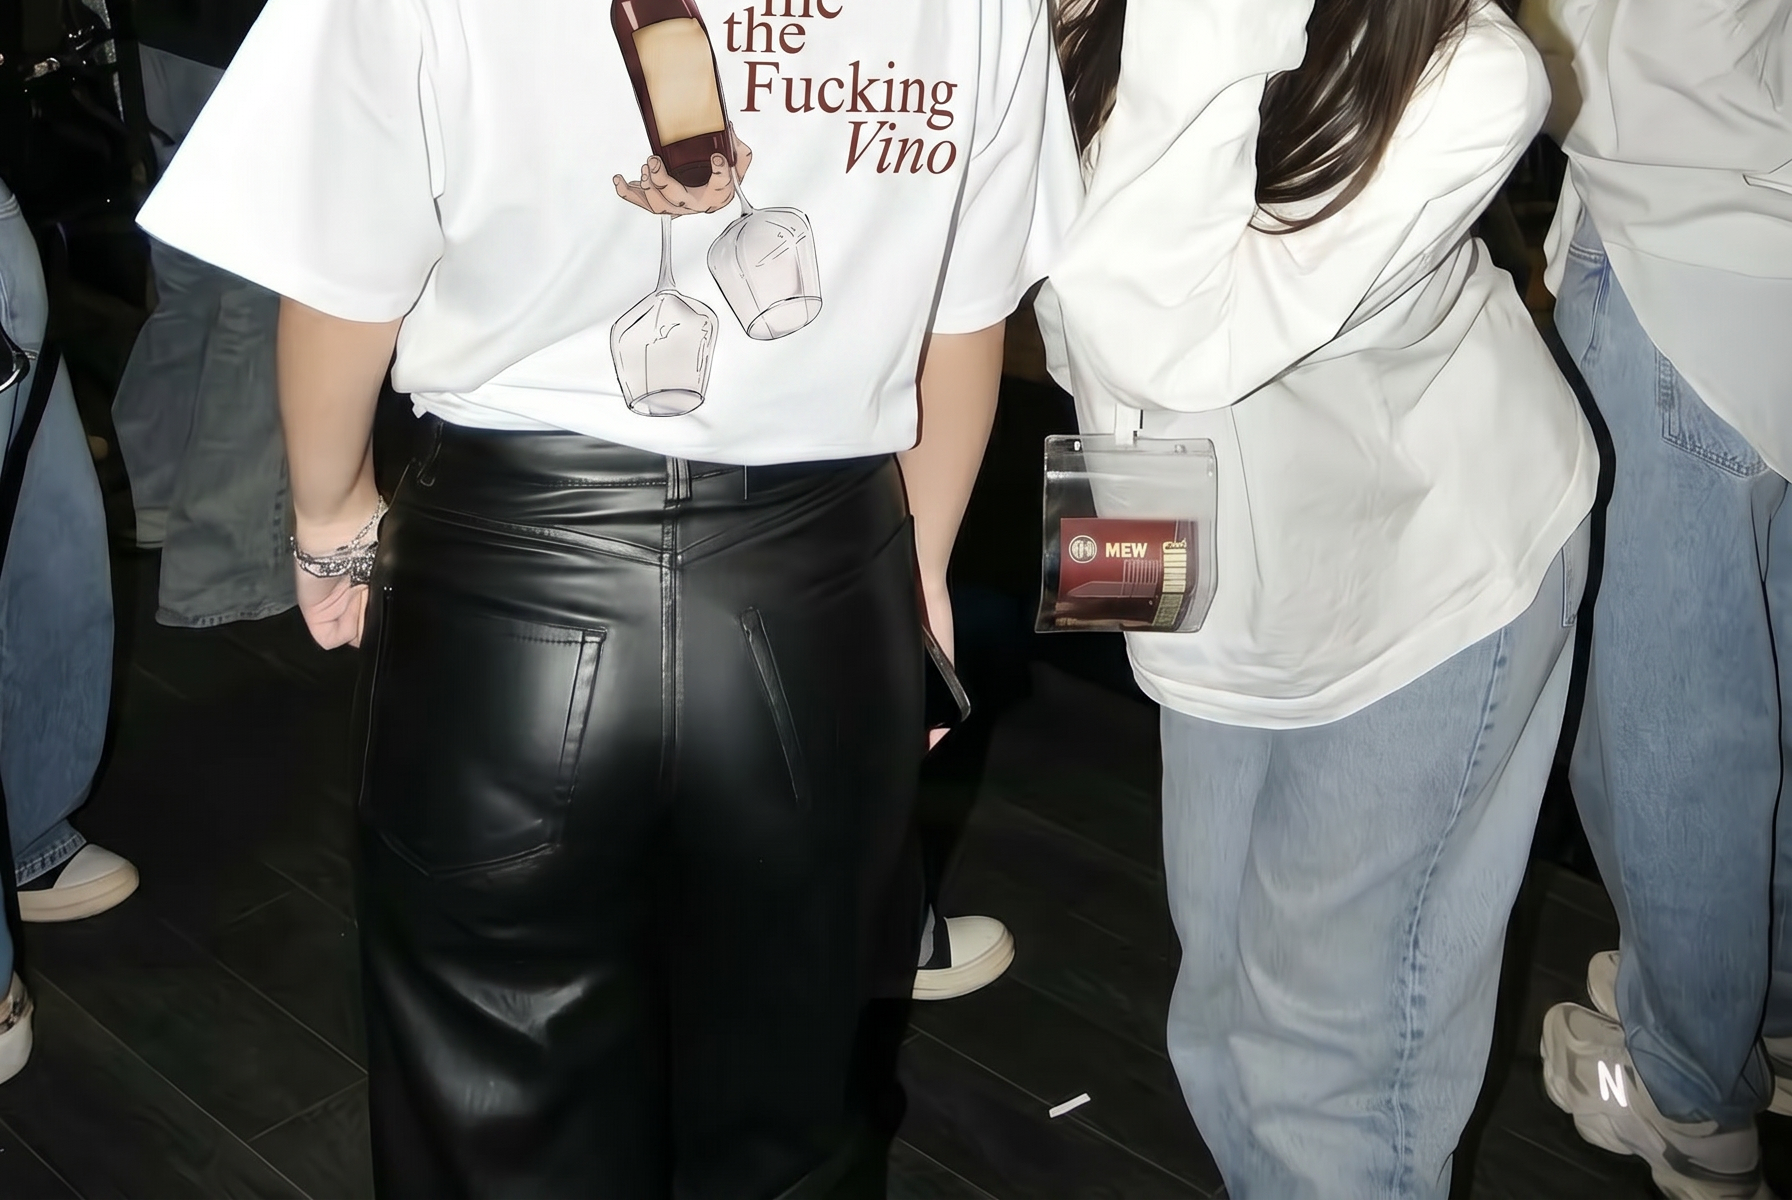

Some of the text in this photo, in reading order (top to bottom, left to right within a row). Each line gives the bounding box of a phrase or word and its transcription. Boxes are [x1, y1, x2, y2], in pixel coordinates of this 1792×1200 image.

[723, 6, 806, 54] the
[740, 60, 958, 131] Fucking
[846, 121, 957, 174] Vino
[1105, 542, 1148, 558] MEW
